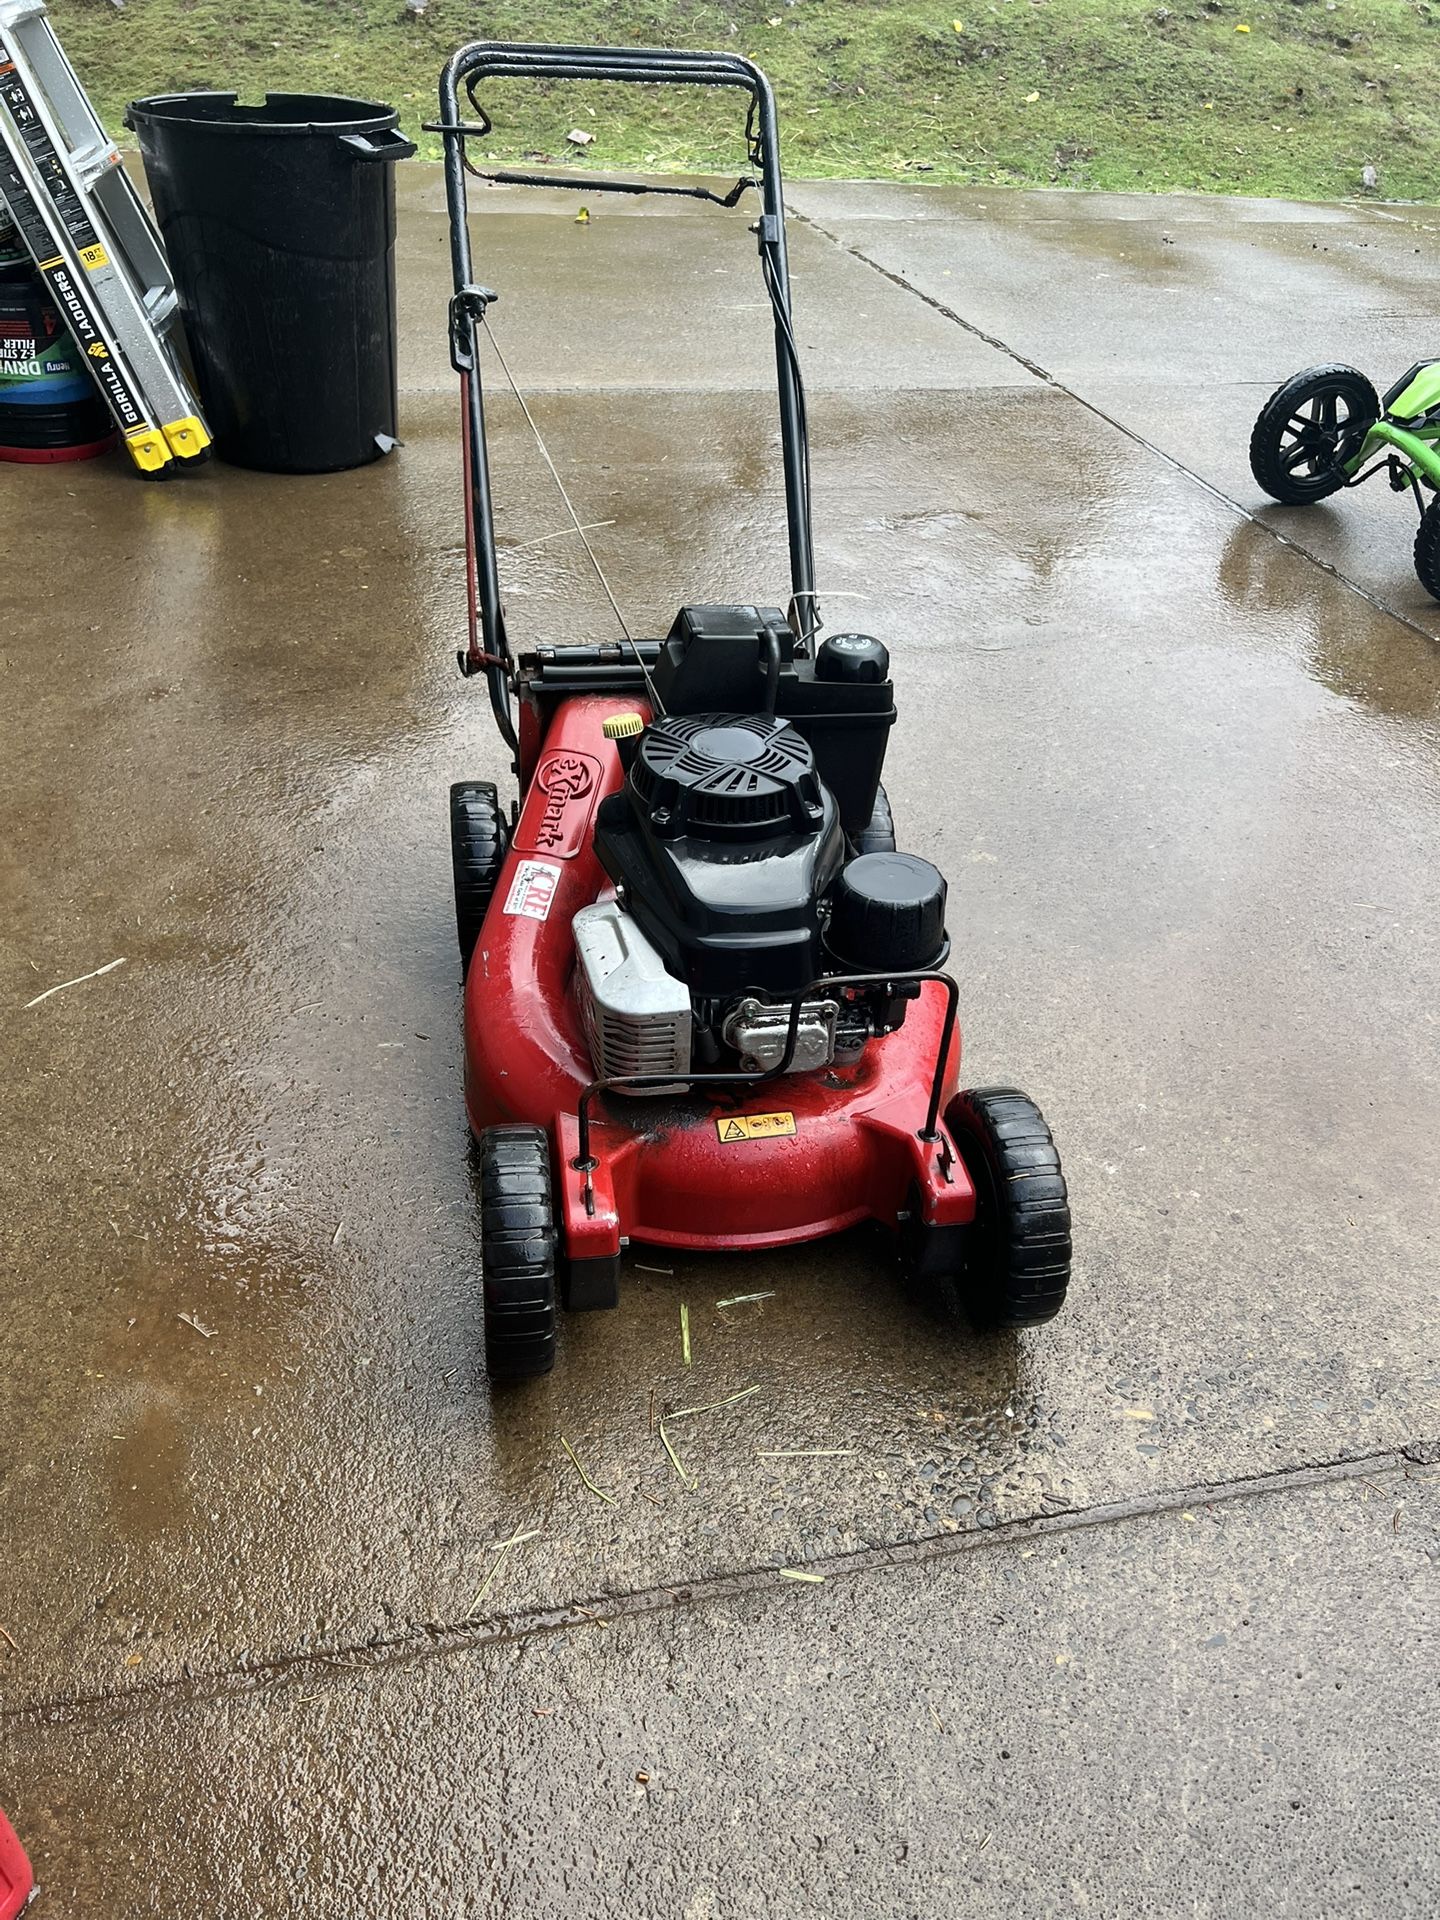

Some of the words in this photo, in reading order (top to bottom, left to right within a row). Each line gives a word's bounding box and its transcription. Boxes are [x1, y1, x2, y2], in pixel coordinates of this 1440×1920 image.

[83, 251, 96, 262] 18
[54, 270, 95, 339] LADDERS
[4, 339, 35, 349] FILLER
[20, 350, 36, 359] E-Z
[46, 362, 70, 371] Henry
[101, 362, 138, 423] GORILLA
